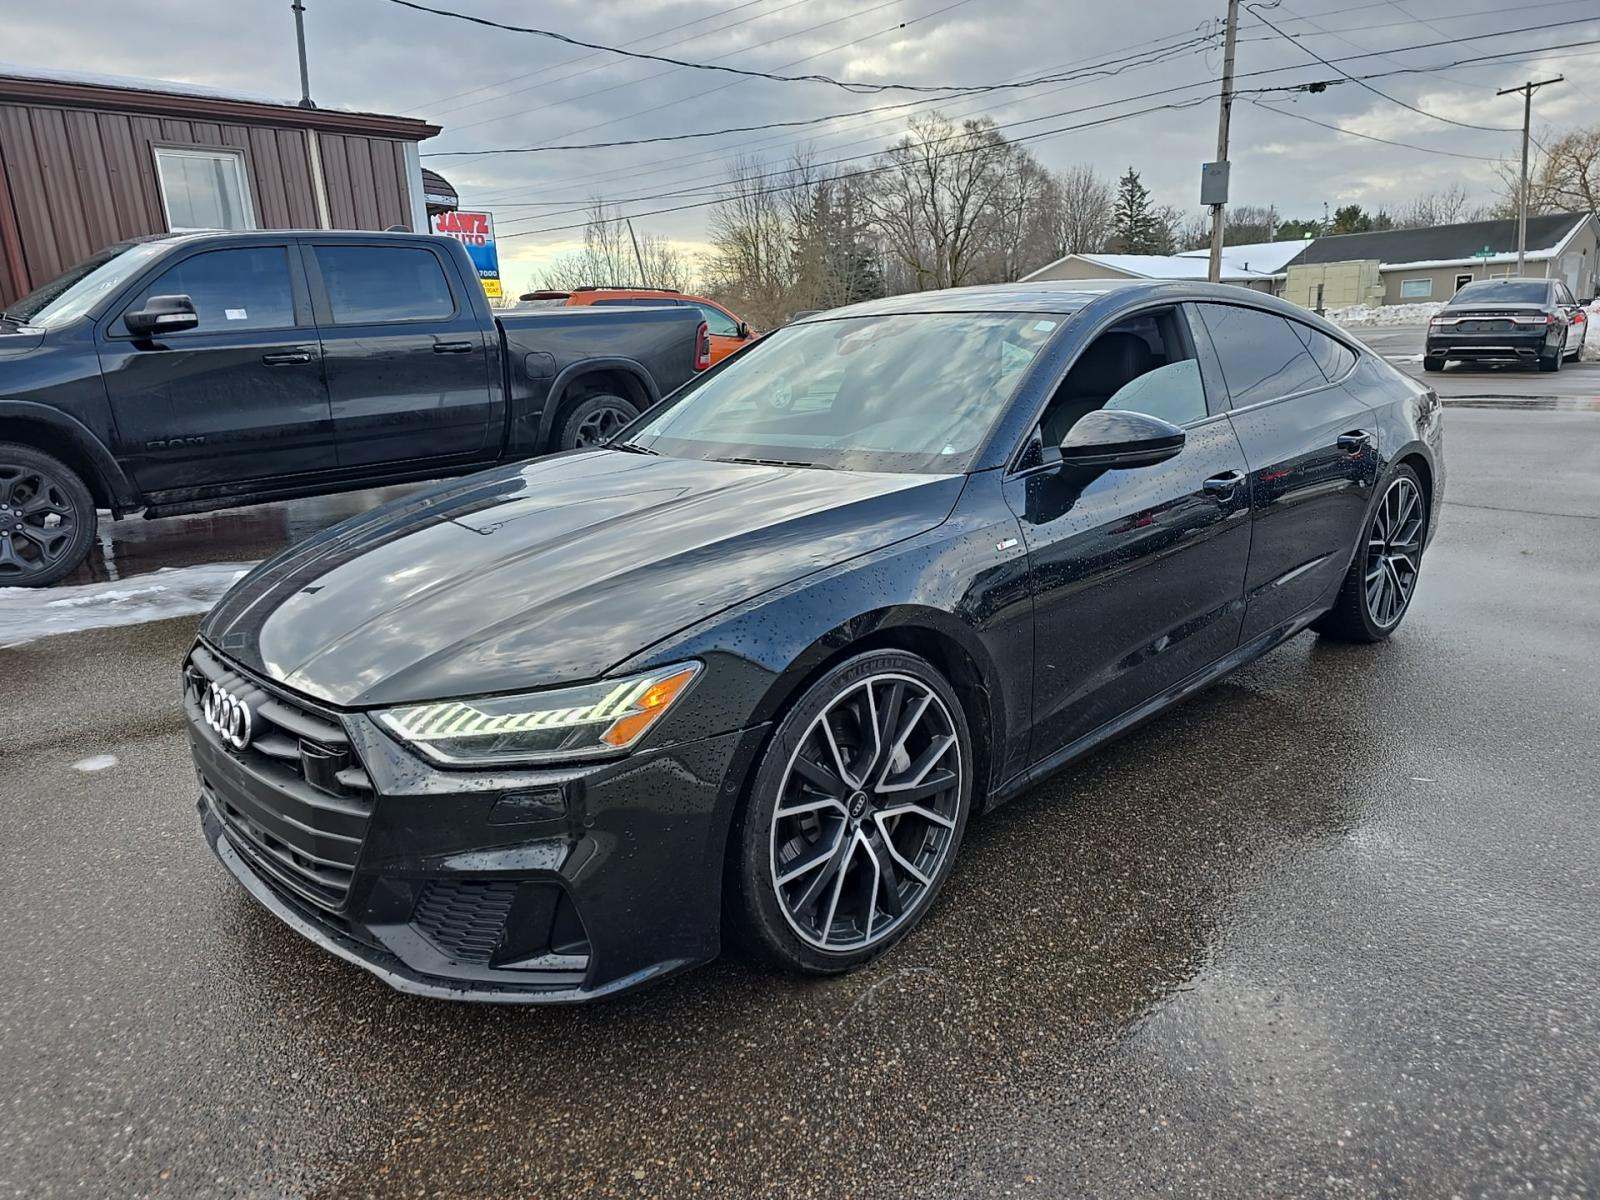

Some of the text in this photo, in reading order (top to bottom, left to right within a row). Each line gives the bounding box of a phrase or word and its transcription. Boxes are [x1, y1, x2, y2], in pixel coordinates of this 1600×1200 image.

[436, 212, 489, 234] JAWZ
[447, 234, 486, 247] UTO
[847, 659, 902, 678] MICHELIN
